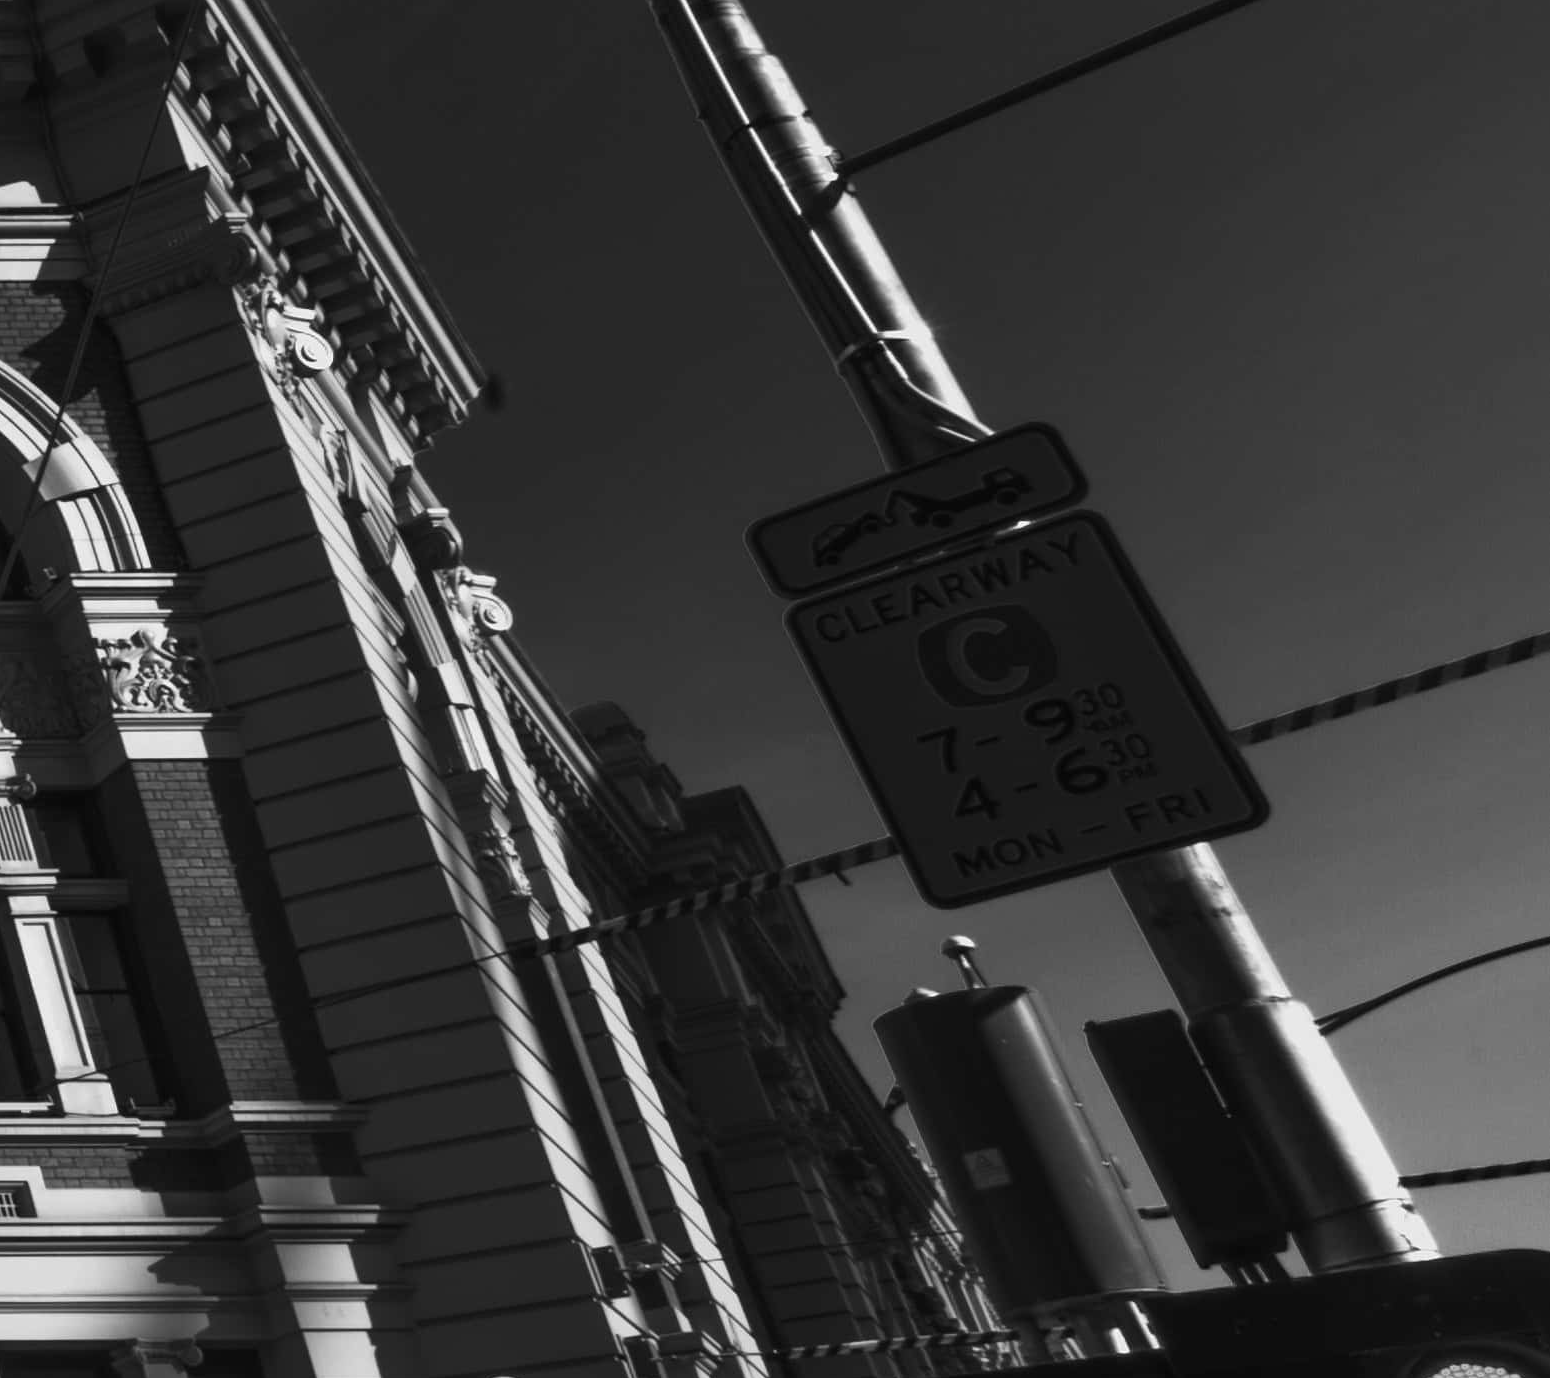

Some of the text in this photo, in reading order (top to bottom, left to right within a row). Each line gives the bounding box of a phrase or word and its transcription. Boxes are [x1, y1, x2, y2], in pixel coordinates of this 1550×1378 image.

[814, 531, 1082, 643] CLEARWAY
[955, 617, 1031, 696] C
[917, 727, 960, 774] 7
[1024, 698, 1075, 744] 9
[1072, 682, 1125, 715] 30
[955, 778, 1001, 823] 4
[1055, 747, 1109, 794] 6
[1100, 733, 1150, 766] 30
[952, 826, 1065, 879] MON
[1123, 788, 1213, 834] FRI
